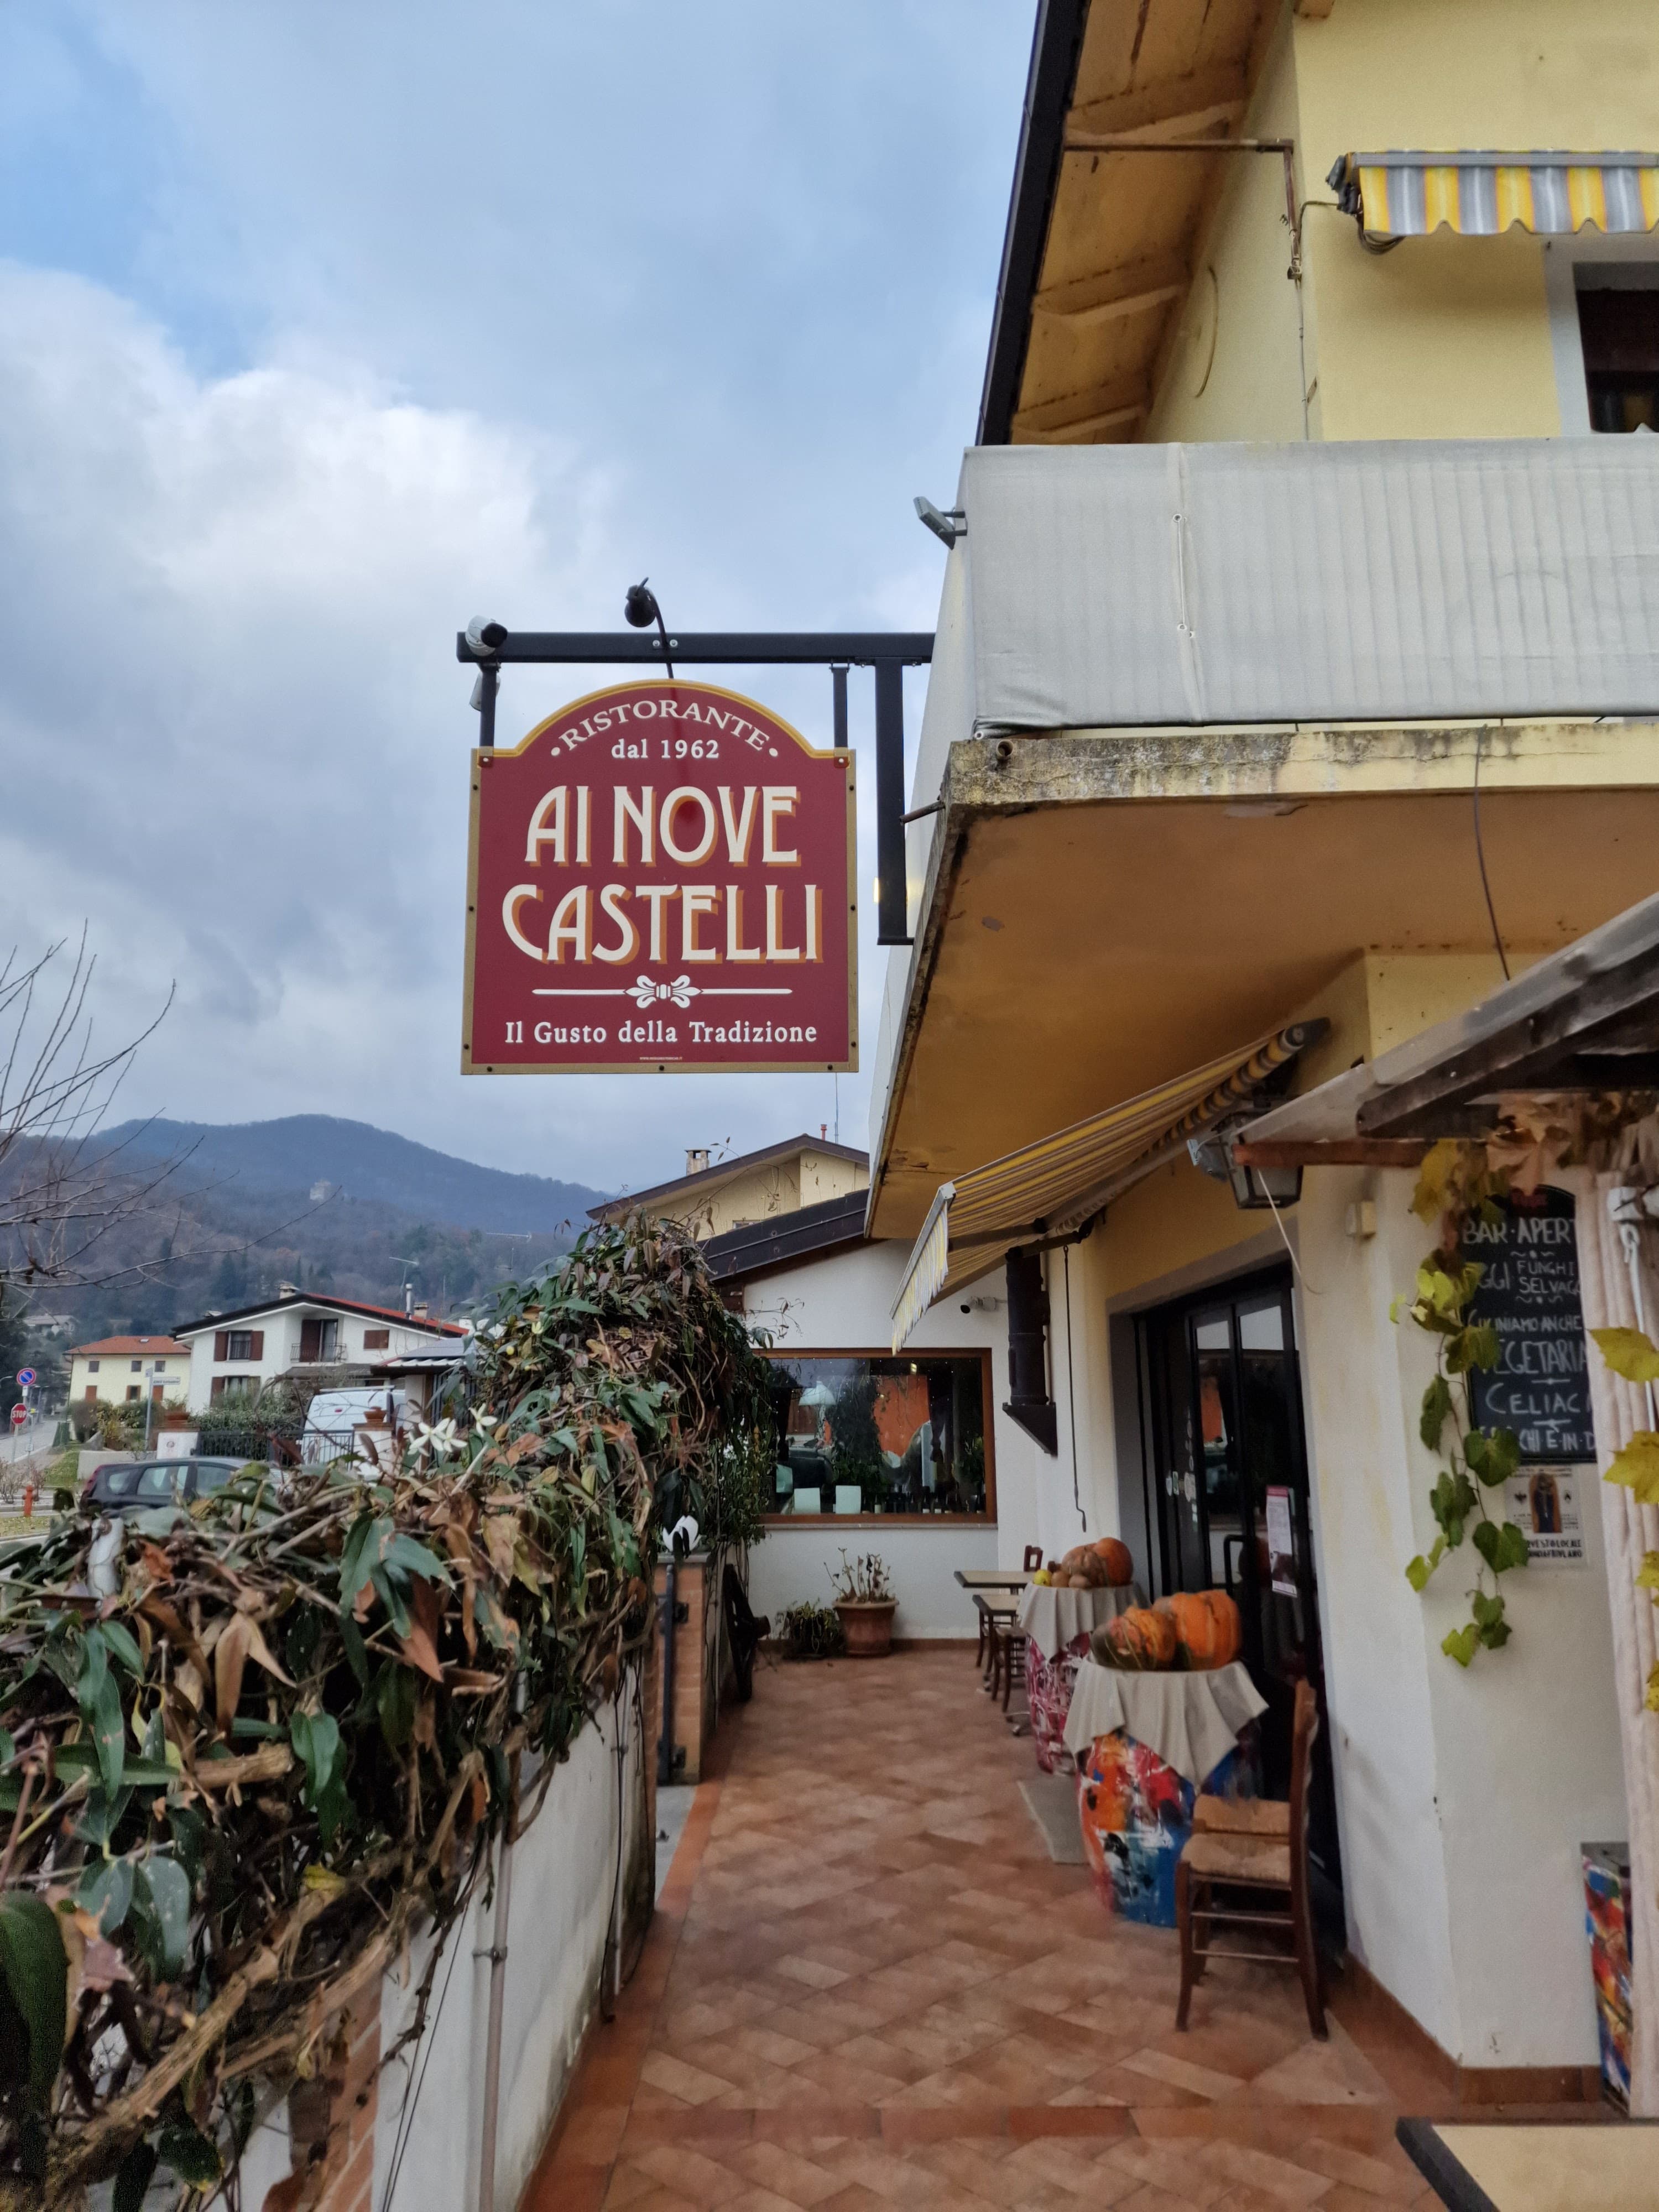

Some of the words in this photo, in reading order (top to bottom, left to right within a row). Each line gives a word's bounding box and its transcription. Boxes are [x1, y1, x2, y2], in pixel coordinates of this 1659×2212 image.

[559, 700, 770, 751] RISTORANTE
[611, 738, 648, 759] dal
[661, 739, 719, 759] 1962
[524, 785, 592, 867] AI
[612, 785, 801, 867] NOVE
[502, 883, 824, 964] CASTELLI
[505, 1021, 523, 1044] Il
[534, 1021, 607, 1044] Gusto
[618, 1020, 677, 1043] della
[688, 1020, 817, 1043] Tradizione
[12, 1410, 27, 1418] STOP
